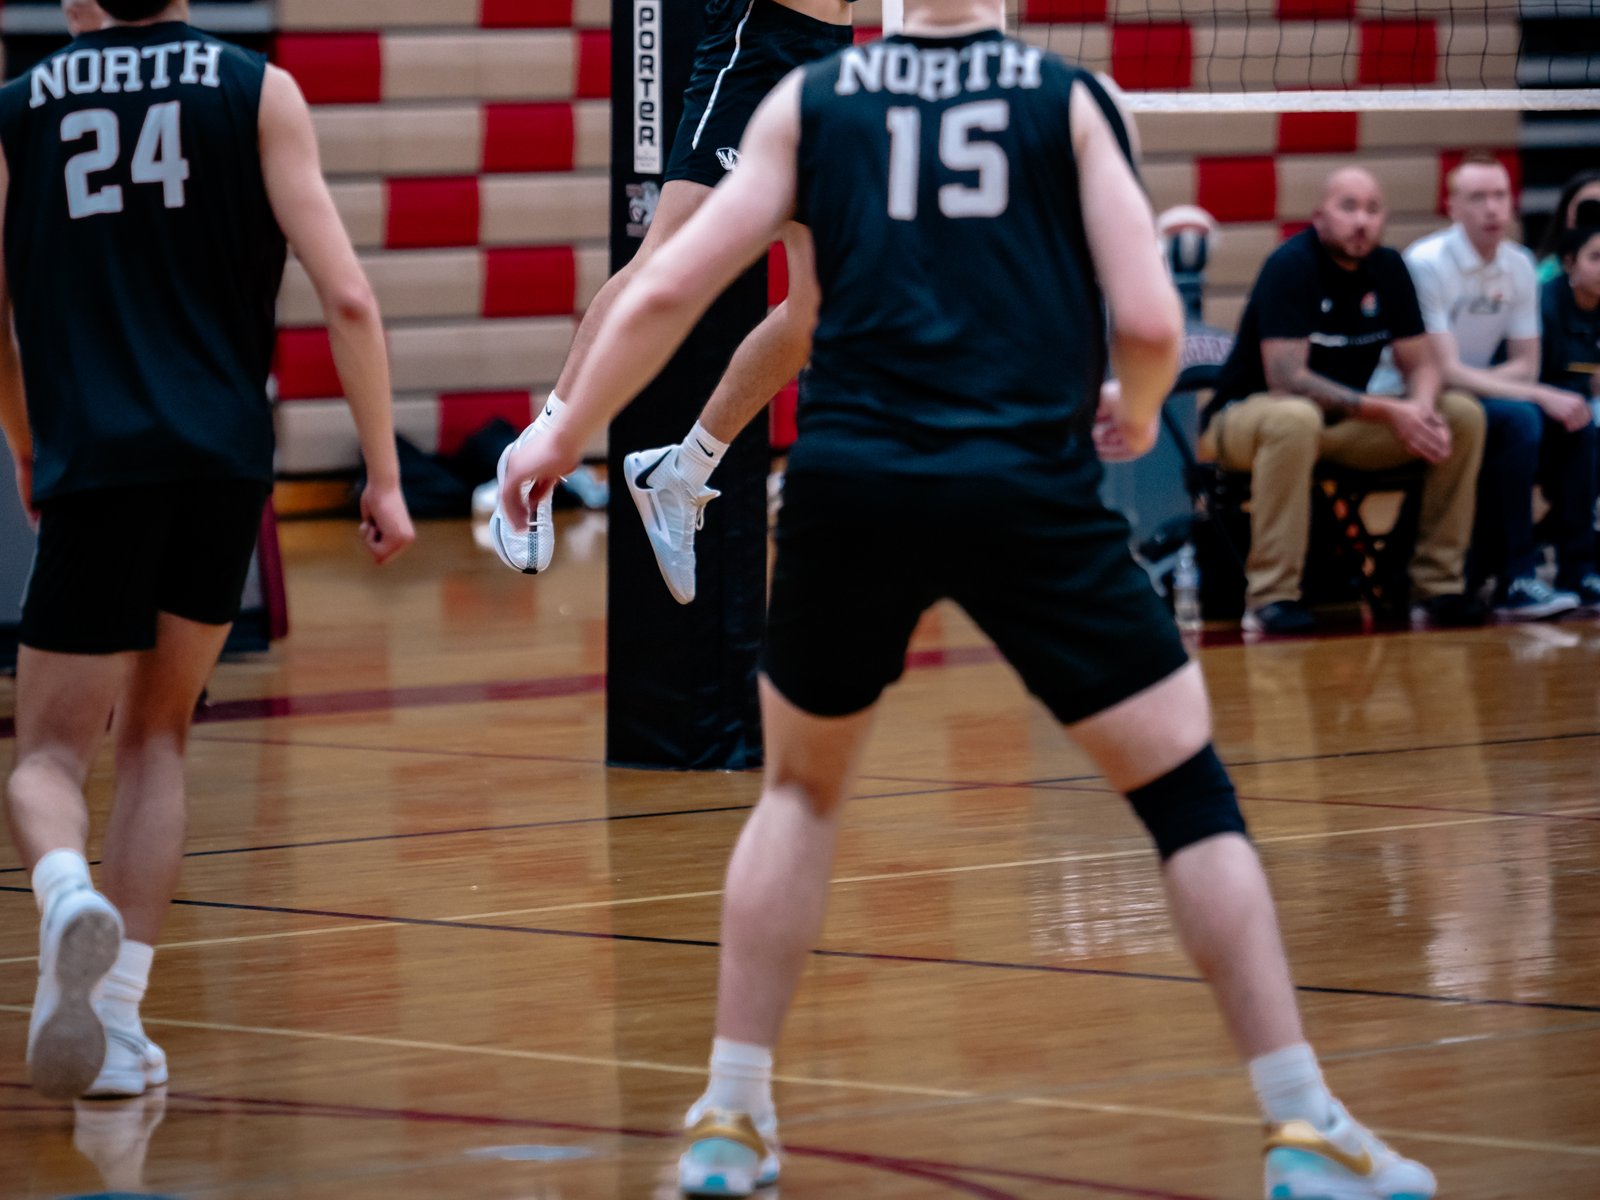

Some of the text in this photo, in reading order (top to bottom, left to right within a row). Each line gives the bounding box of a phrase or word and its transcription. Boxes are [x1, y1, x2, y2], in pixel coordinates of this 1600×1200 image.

[29, 40, 222, 109] NORTH
[638, 6, 656, 147] PORTER
[834, 41, 1043, 102] NORTH
[60, 100, 189, 220] 24
[886, 99, 1010, 221] 15
